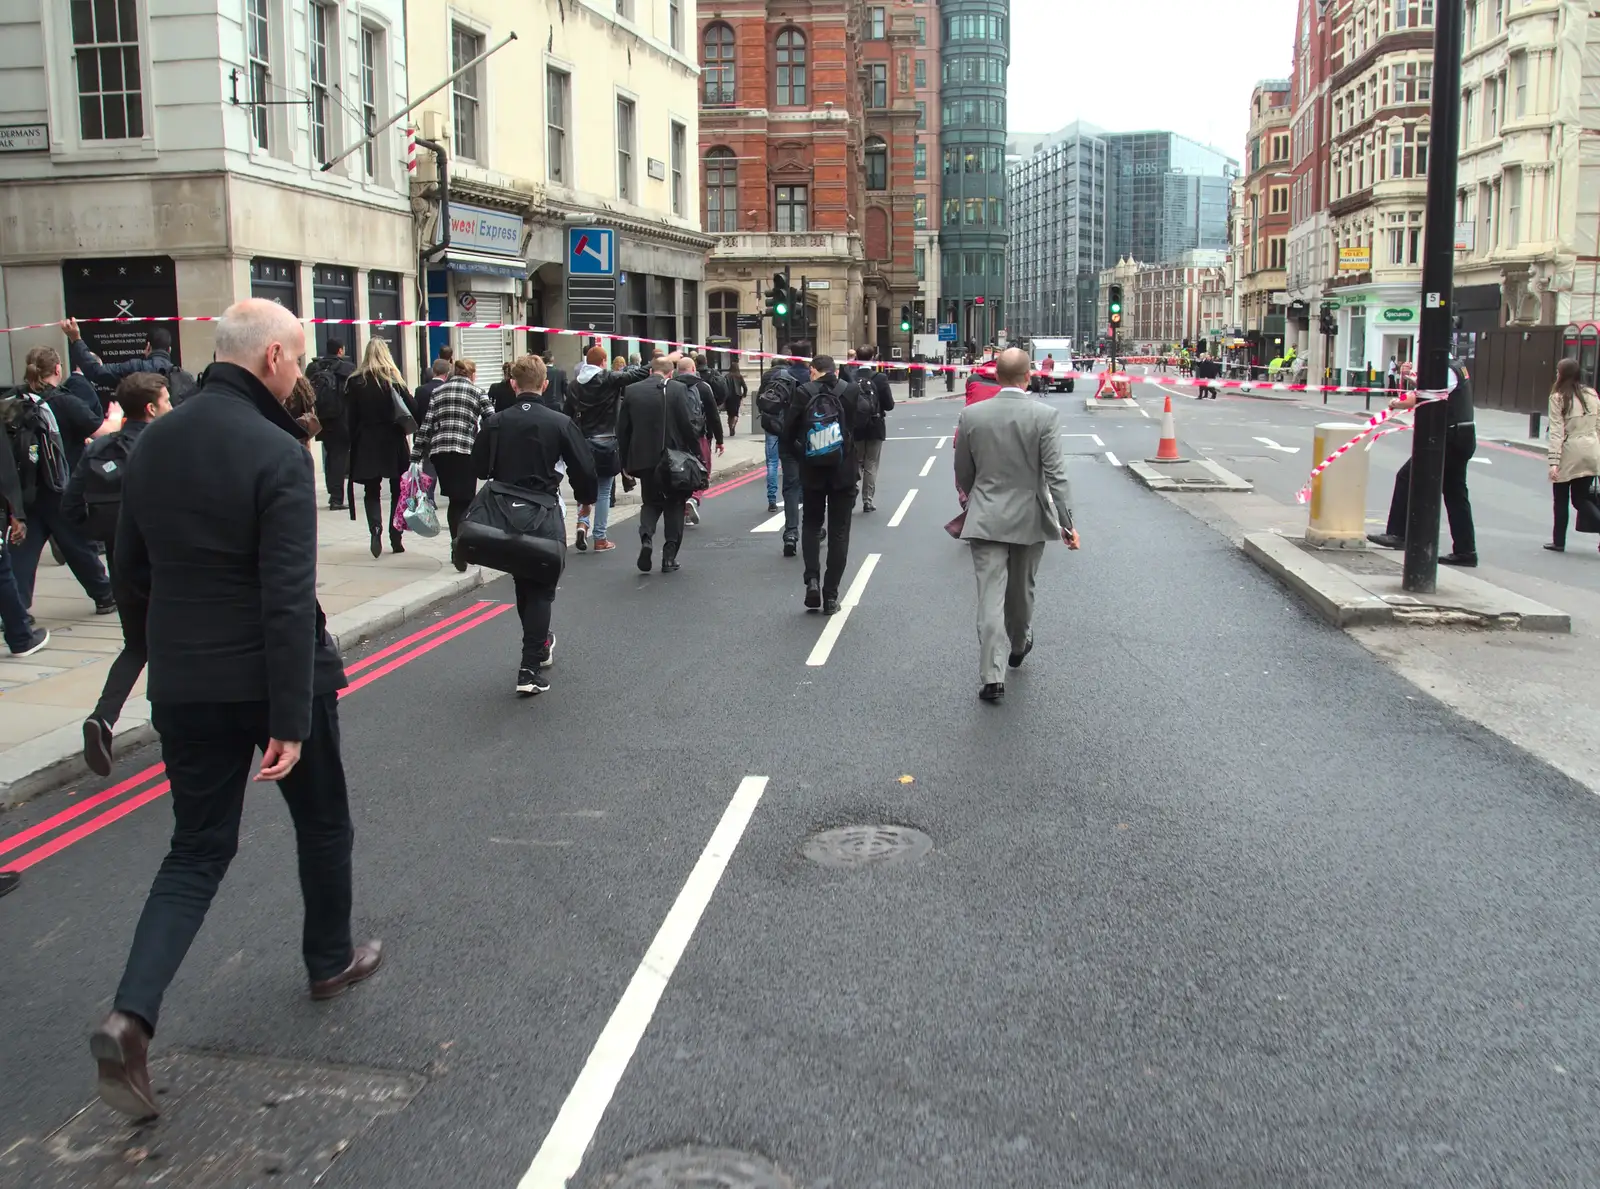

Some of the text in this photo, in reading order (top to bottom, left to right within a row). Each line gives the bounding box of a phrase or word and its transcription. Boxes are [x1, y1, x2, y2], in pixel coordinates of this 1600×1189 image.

[0, 129, 41, 138] DERMAN'S
[0, 139, 14, 148] ALK
[451, 218, 517, 242] weet Express
[1430, 293, 1436, 302] 5
[809, 422, 844, 451] NIKE
